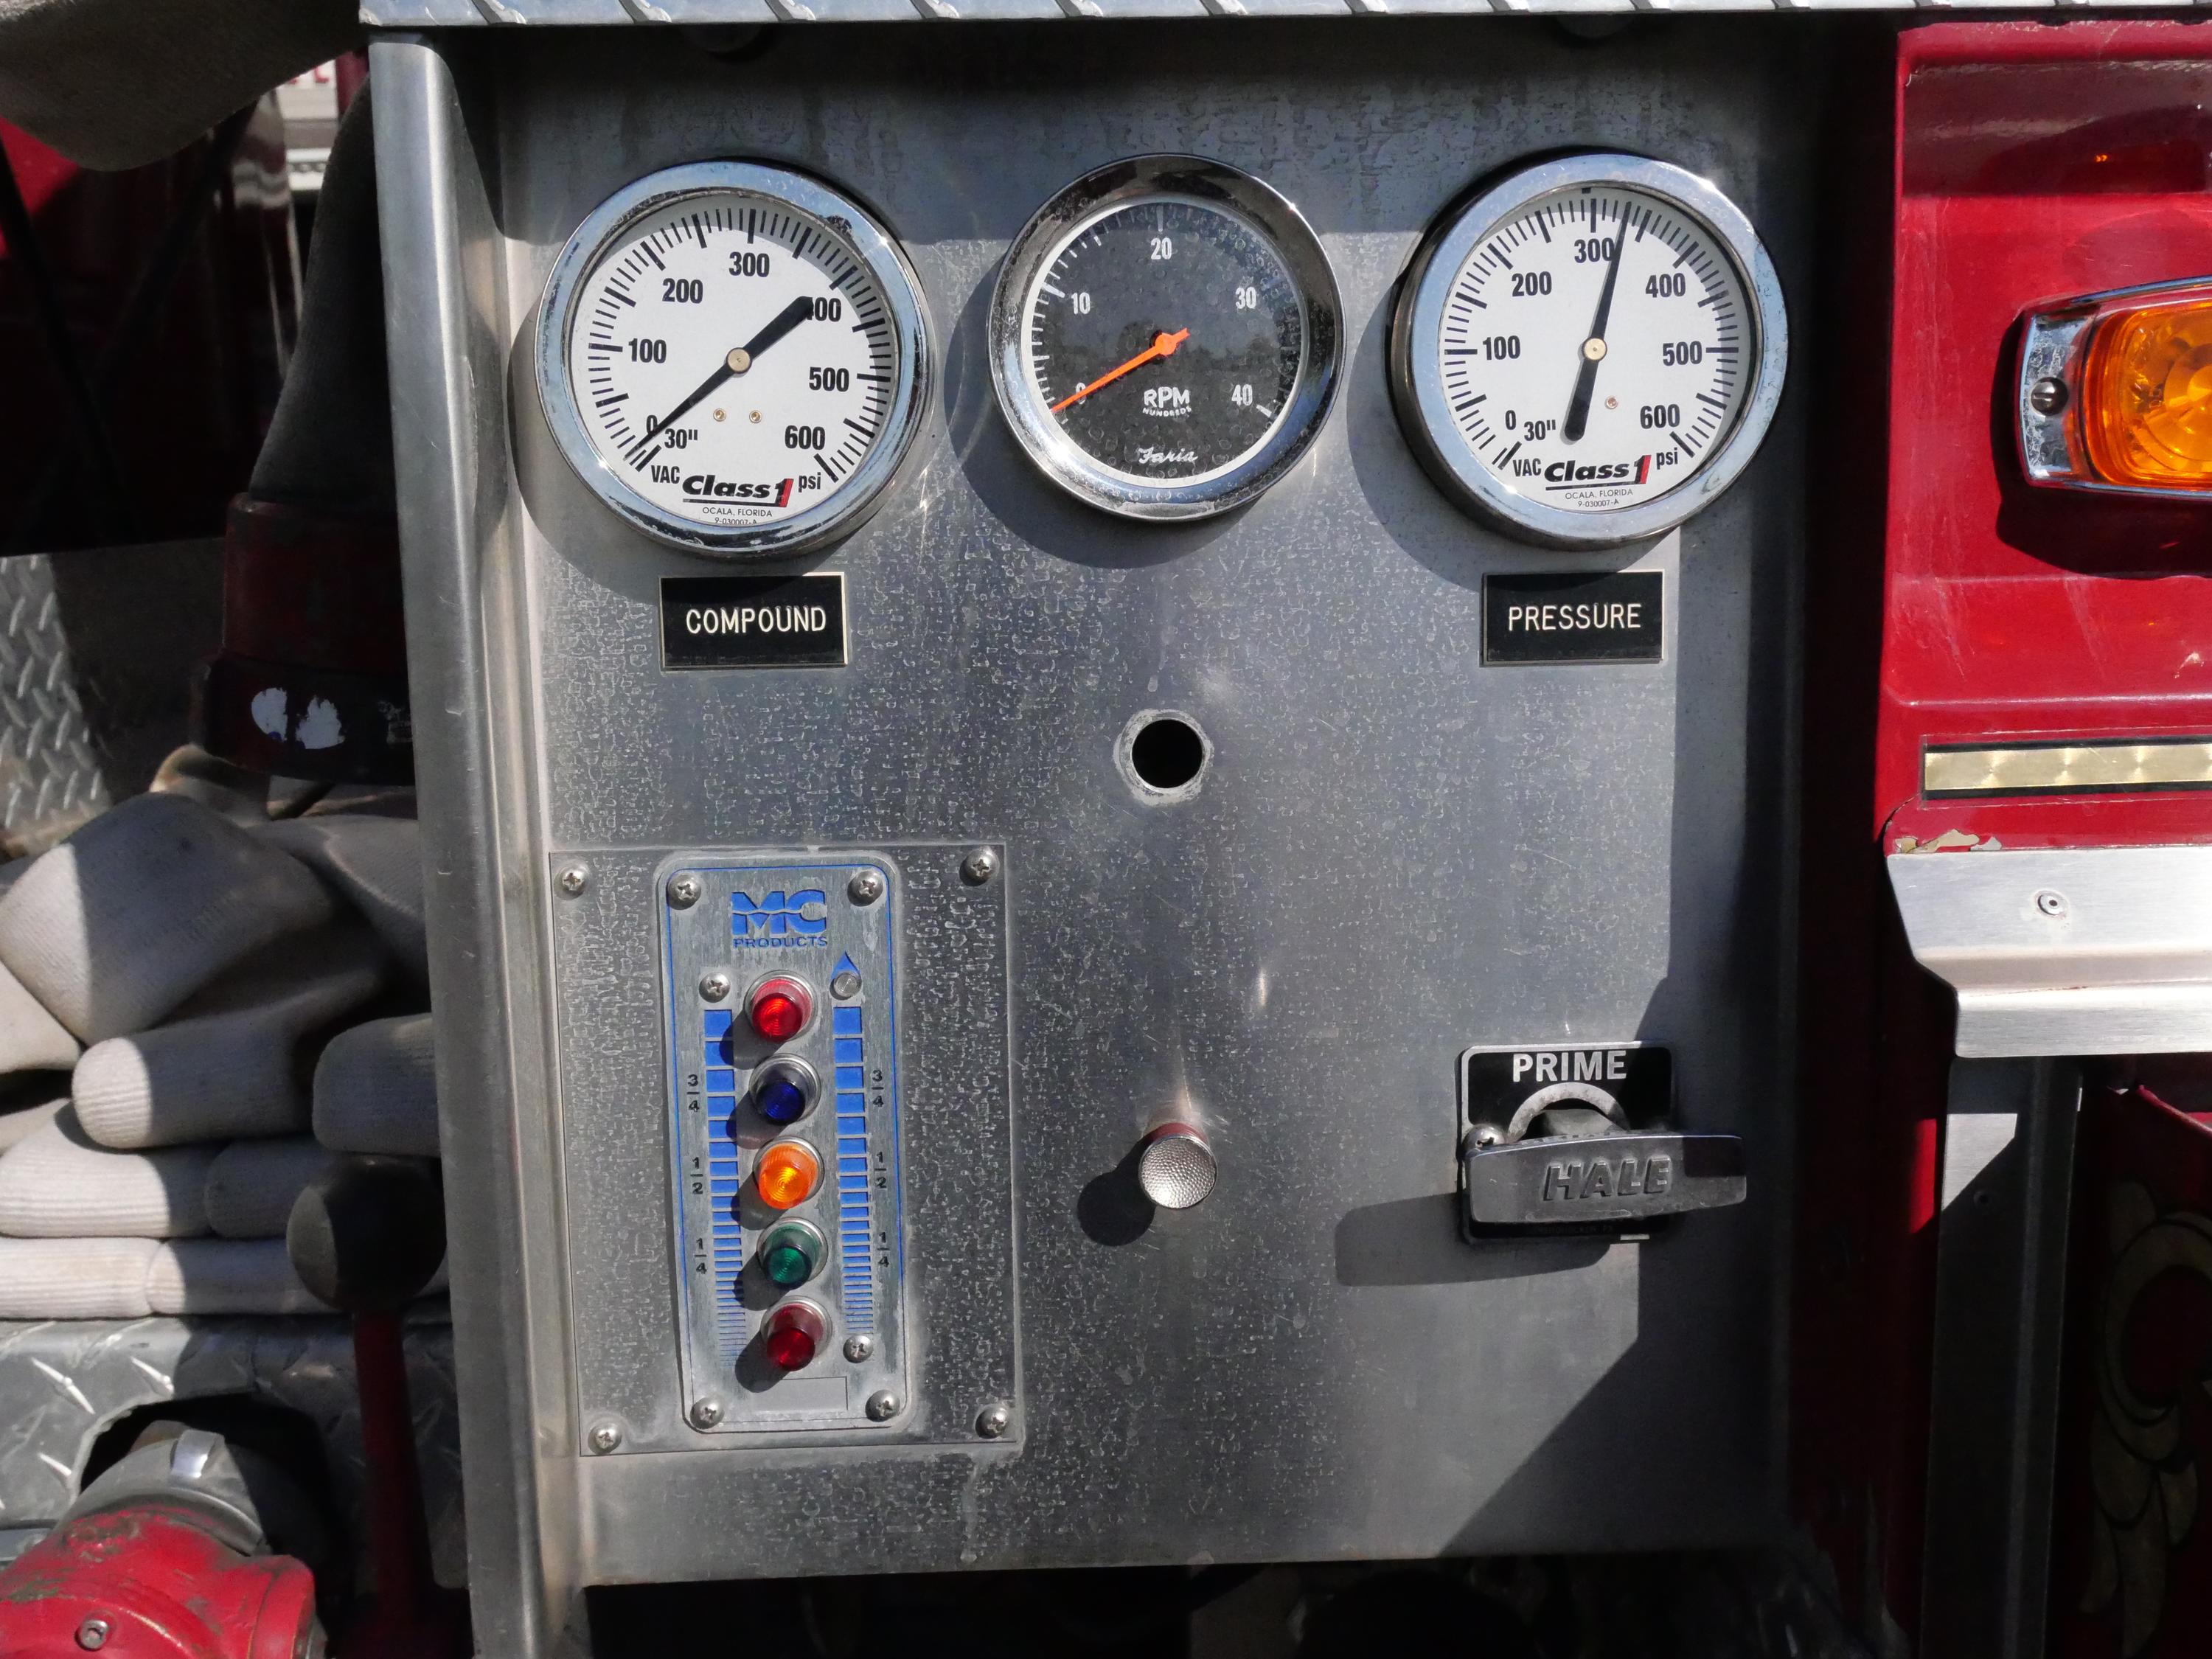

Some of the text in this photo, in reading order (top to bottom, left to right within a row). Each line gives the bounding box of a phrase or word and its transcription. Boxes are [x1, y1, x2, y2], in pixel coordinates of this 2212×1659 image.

[1150, 237, 1172, 260] 20
[1574, 237, 1615, 263] 300
[728, 252, 771, 277] 300
[663, 279, 703, 304] 200
[1512, 272, 1553, 296] 200
[1645, 273, 1686, 298] 400
[1071, 293, 1091, 314] 10
[1235, 288, 1256, 310] 30
[629, 338, 667, 364] 100
[1483, 335, 1520, 361] 100
[1663, 341, 1703, 366] 500
[809, 367, 849, 392] 500
[1144, 386, 1190, 408] RPM
[1231, 384, 1253, 406] 40
[647, 414, 658, 435] 0
[1505, 410, 1517, 431] 0
[1640, 404, 1681, 429] 600
[664, 428, 698, 449] 30"
[785, 426, 825, 450] 600
[1523, 420, 1557, 441] 30"
[1138, 446, 1199, 465] Faria
[1656, 447, 1678, 470] psi
[650, 465, 680, 484] VAC
[1513, 458, 1542, 477] VAC
[798, 472, 821, 493] psi
[1565, 488, 1633, 500] OCALA, FLORIDA
[702, 507, 772, 517] OCALA, FLORIDA
[1577, 499, 1619, 507] 9-030007-A
[686, 607, 827, 634] COMPOUND
[1509, 604, 1642, 631] PRESSURE
[731, 889, 827, 934] MC
[732, 936, 828, 948] PRODUCTS
[1512, 1050, 1627, 1082] PRIME
[1543, 1154, 1672, 1202] HALE
